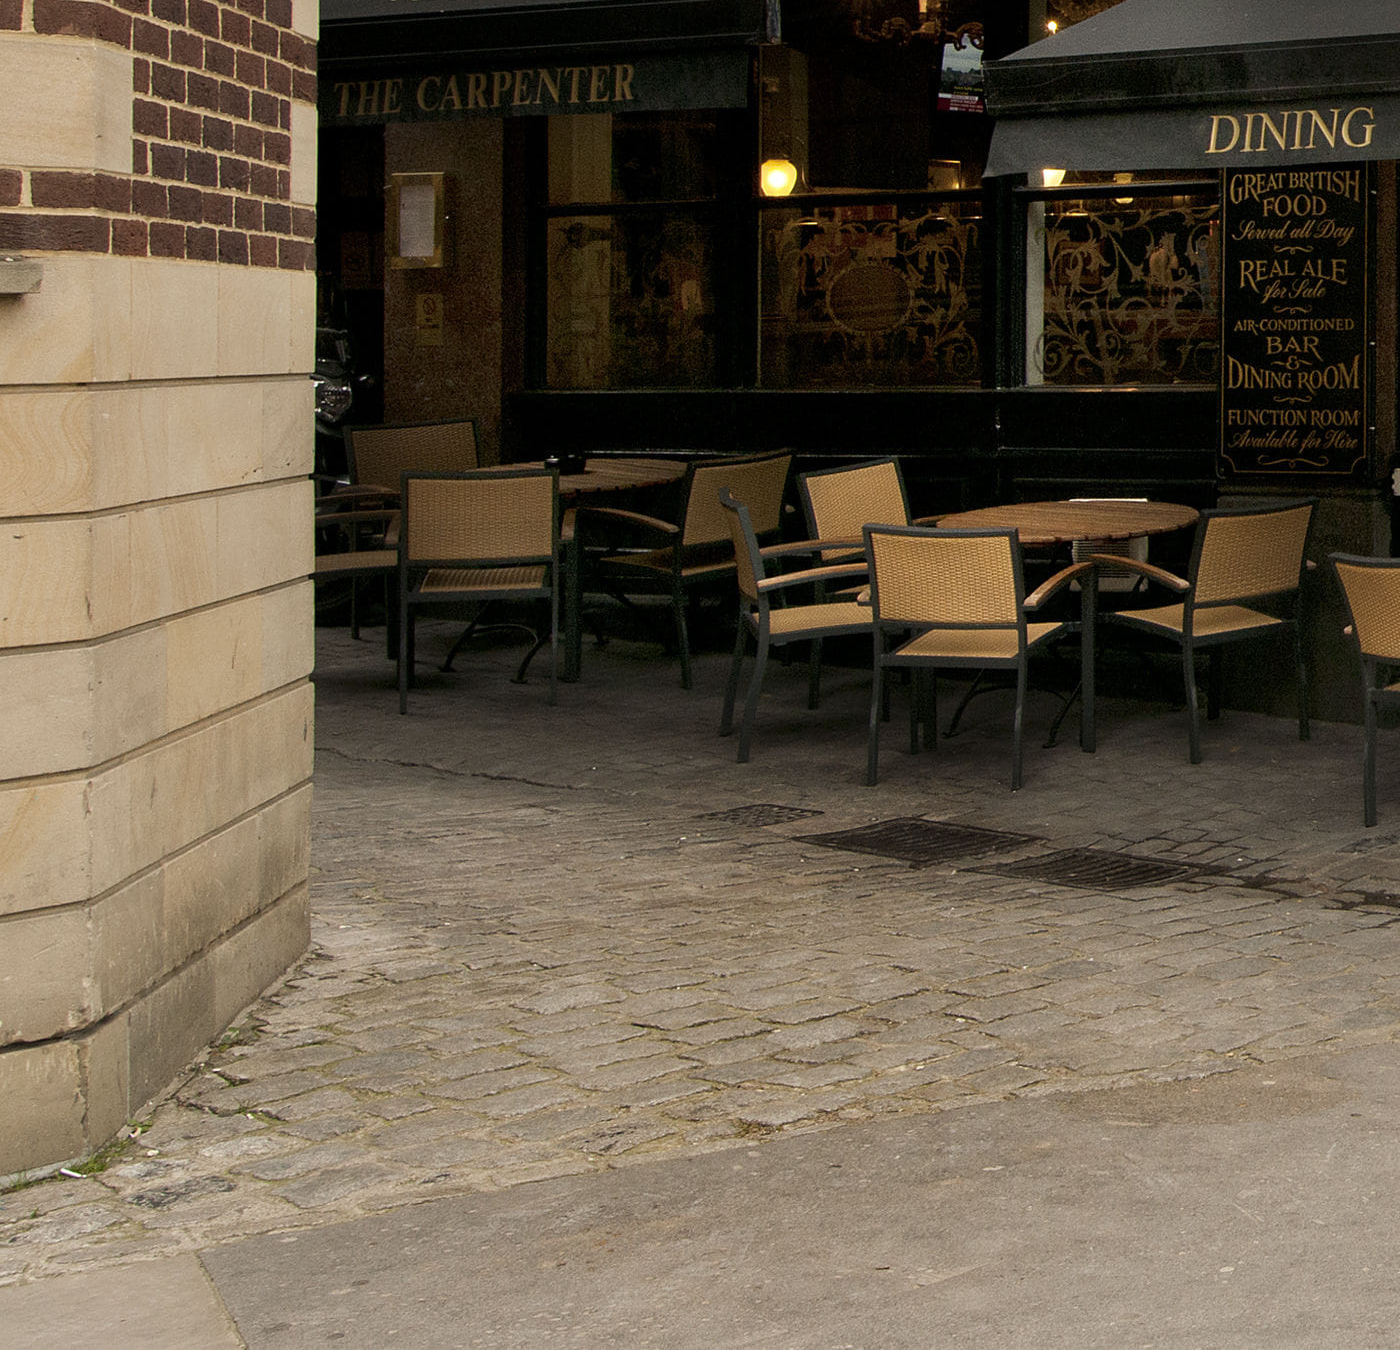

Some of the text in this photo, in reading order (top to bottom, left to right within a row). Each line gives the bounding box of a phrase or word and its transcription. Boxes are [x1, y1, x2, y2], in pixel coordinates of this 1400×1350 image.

[335, 63, 635, 117] THE CARPENTER
[1204, 105, 1376, 154] DINING
[1229, 170, 1360, 204] GREAT BRITISH
[1263, 195, 1327, 217] FOOD
[1232, 219, 1355, 246] Served all Day
[1239, 259, 1348, 293] REAL ALE
[1262, 279, 1326, 303] for Sale
[1233, 318, 1354, 336] AIR-CONDITIONED
[1266, 336, 1324, 361] BAR
[1227, 354, 1360, 394] DINING ROOM
[1228, 409, 1360, 429] FUNCTION ROOM
[1228, 430, 1358, 454] Available for Hire
